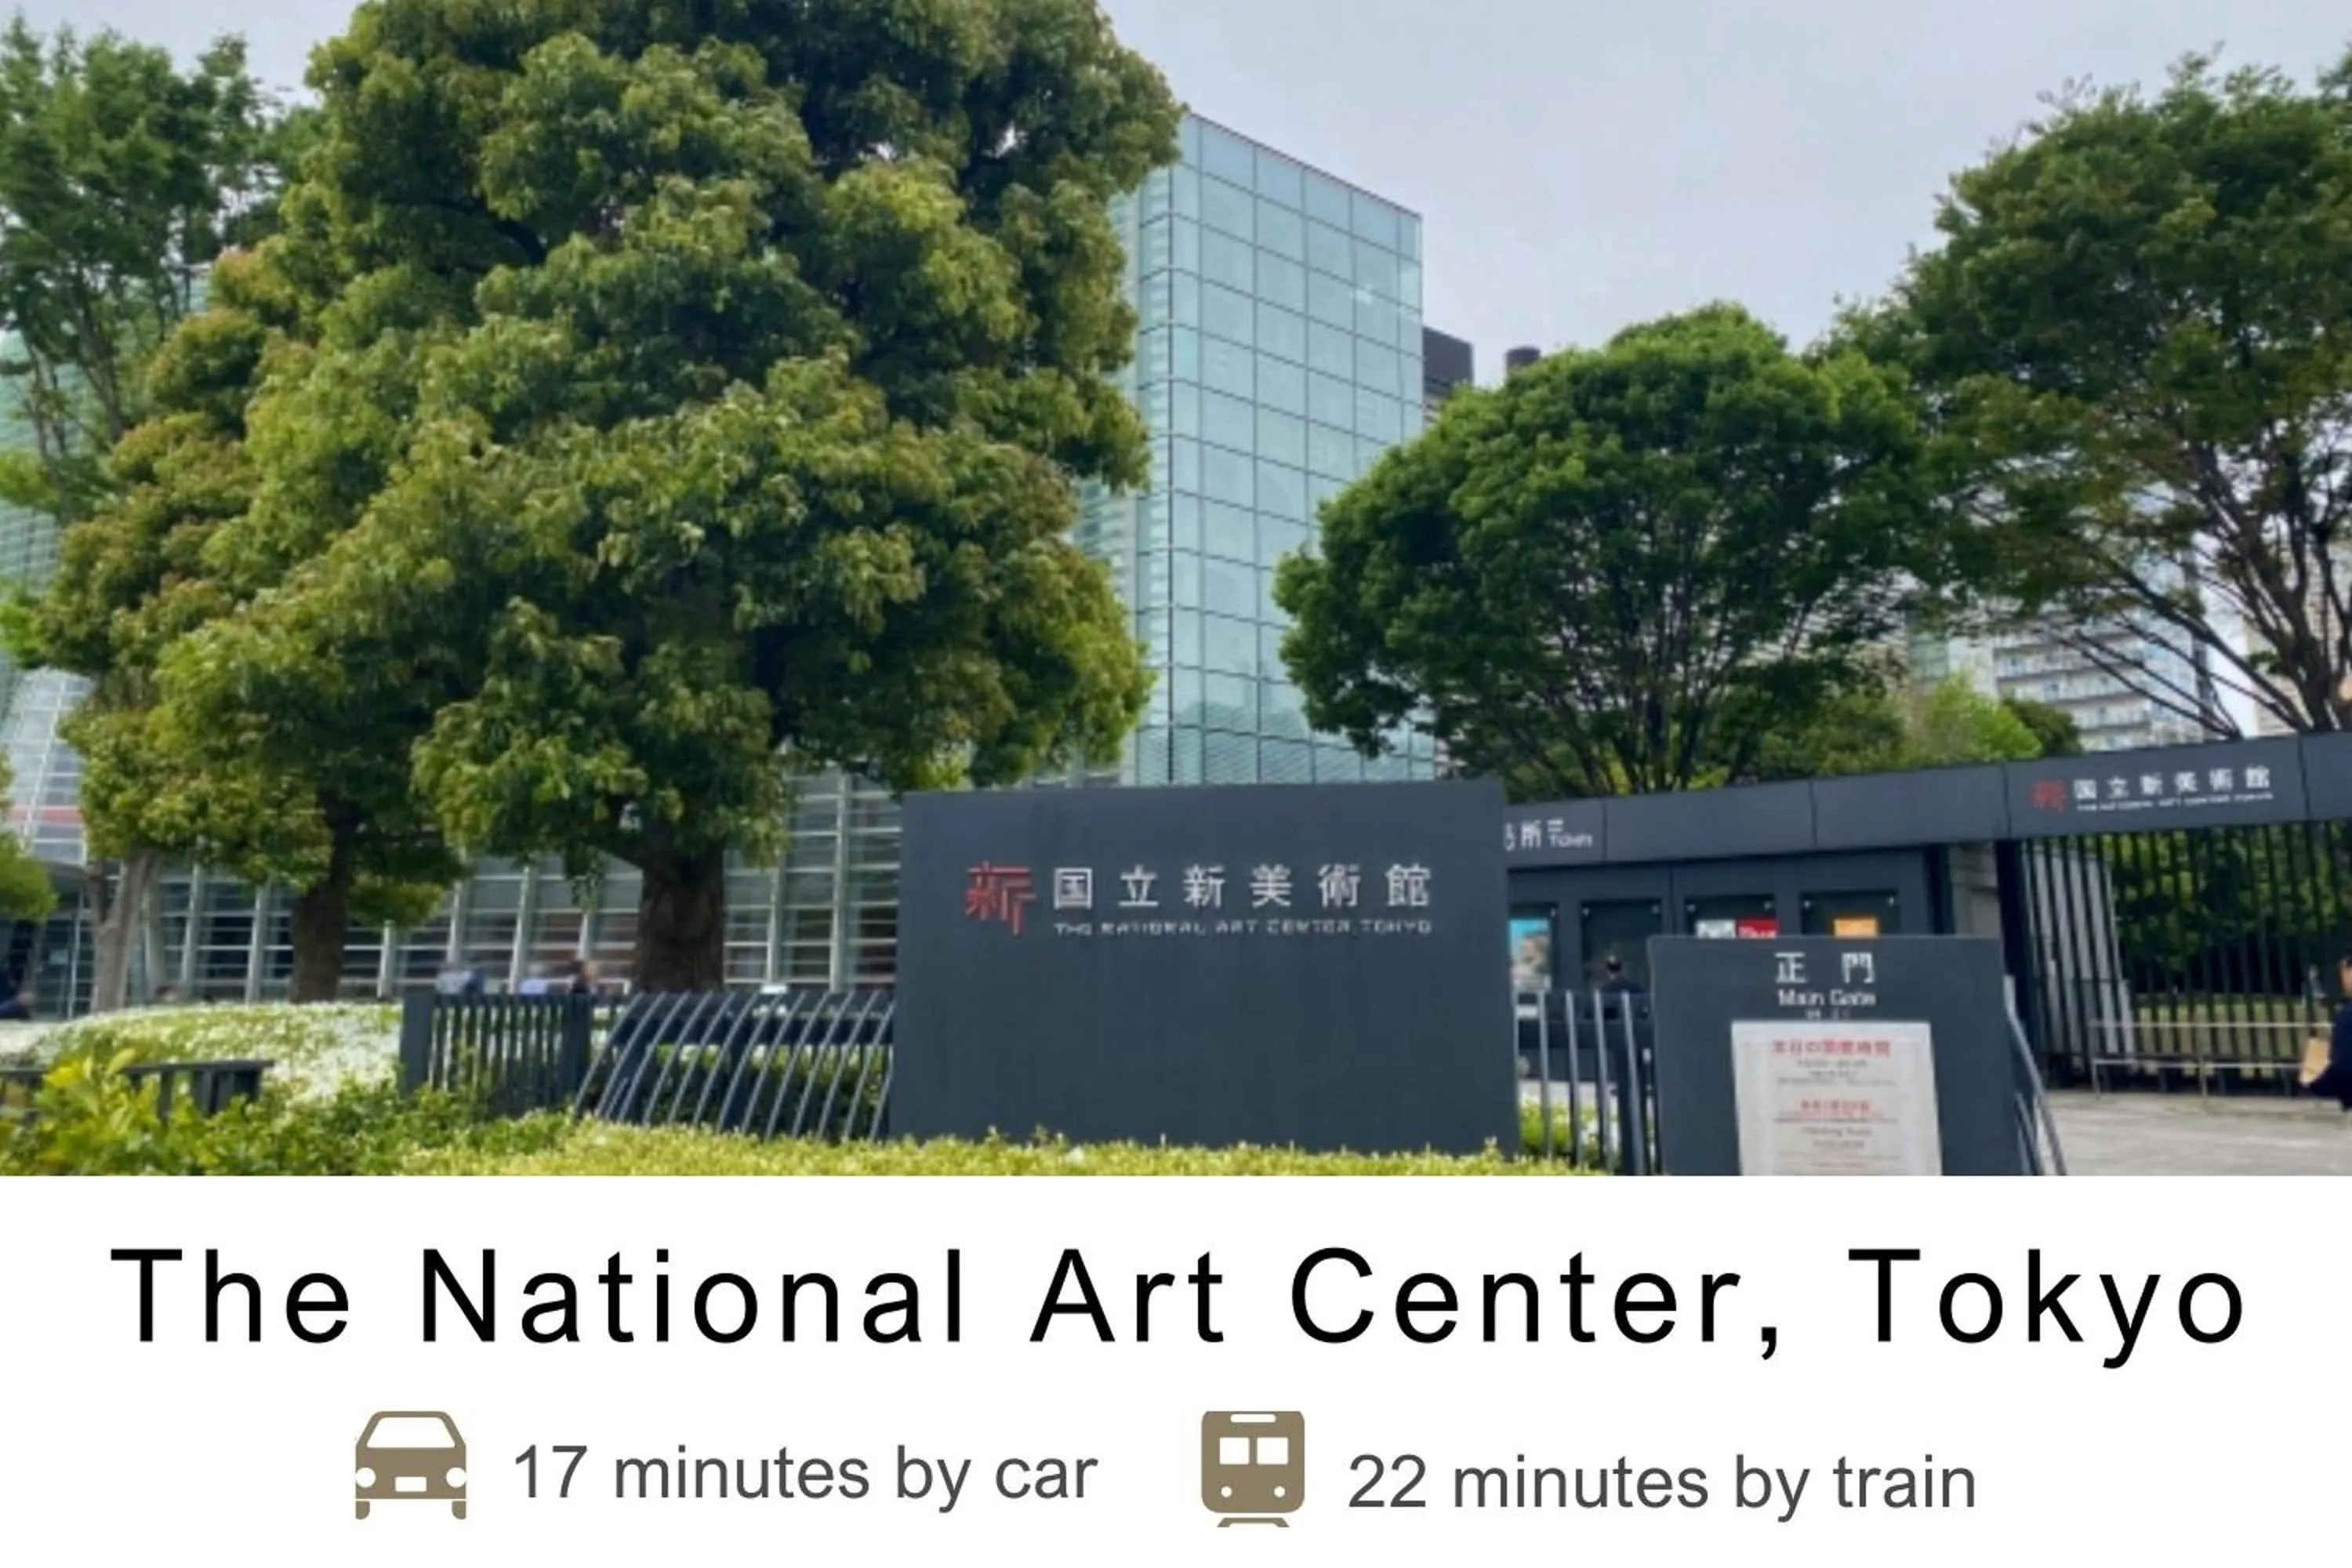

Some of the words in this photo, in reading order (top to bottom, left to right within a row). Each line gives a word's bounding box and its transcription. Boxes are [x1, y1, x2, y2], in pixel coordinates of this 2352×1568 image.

[1053, 862, 1432, 909] 国立新美術館
[1214, 918, 1258, 935] ART
[1774, 951, 1875, 985] 正門
[1777, 989, 1825, 1007] Main
[1829, 989, 1876, 1007] Gate
